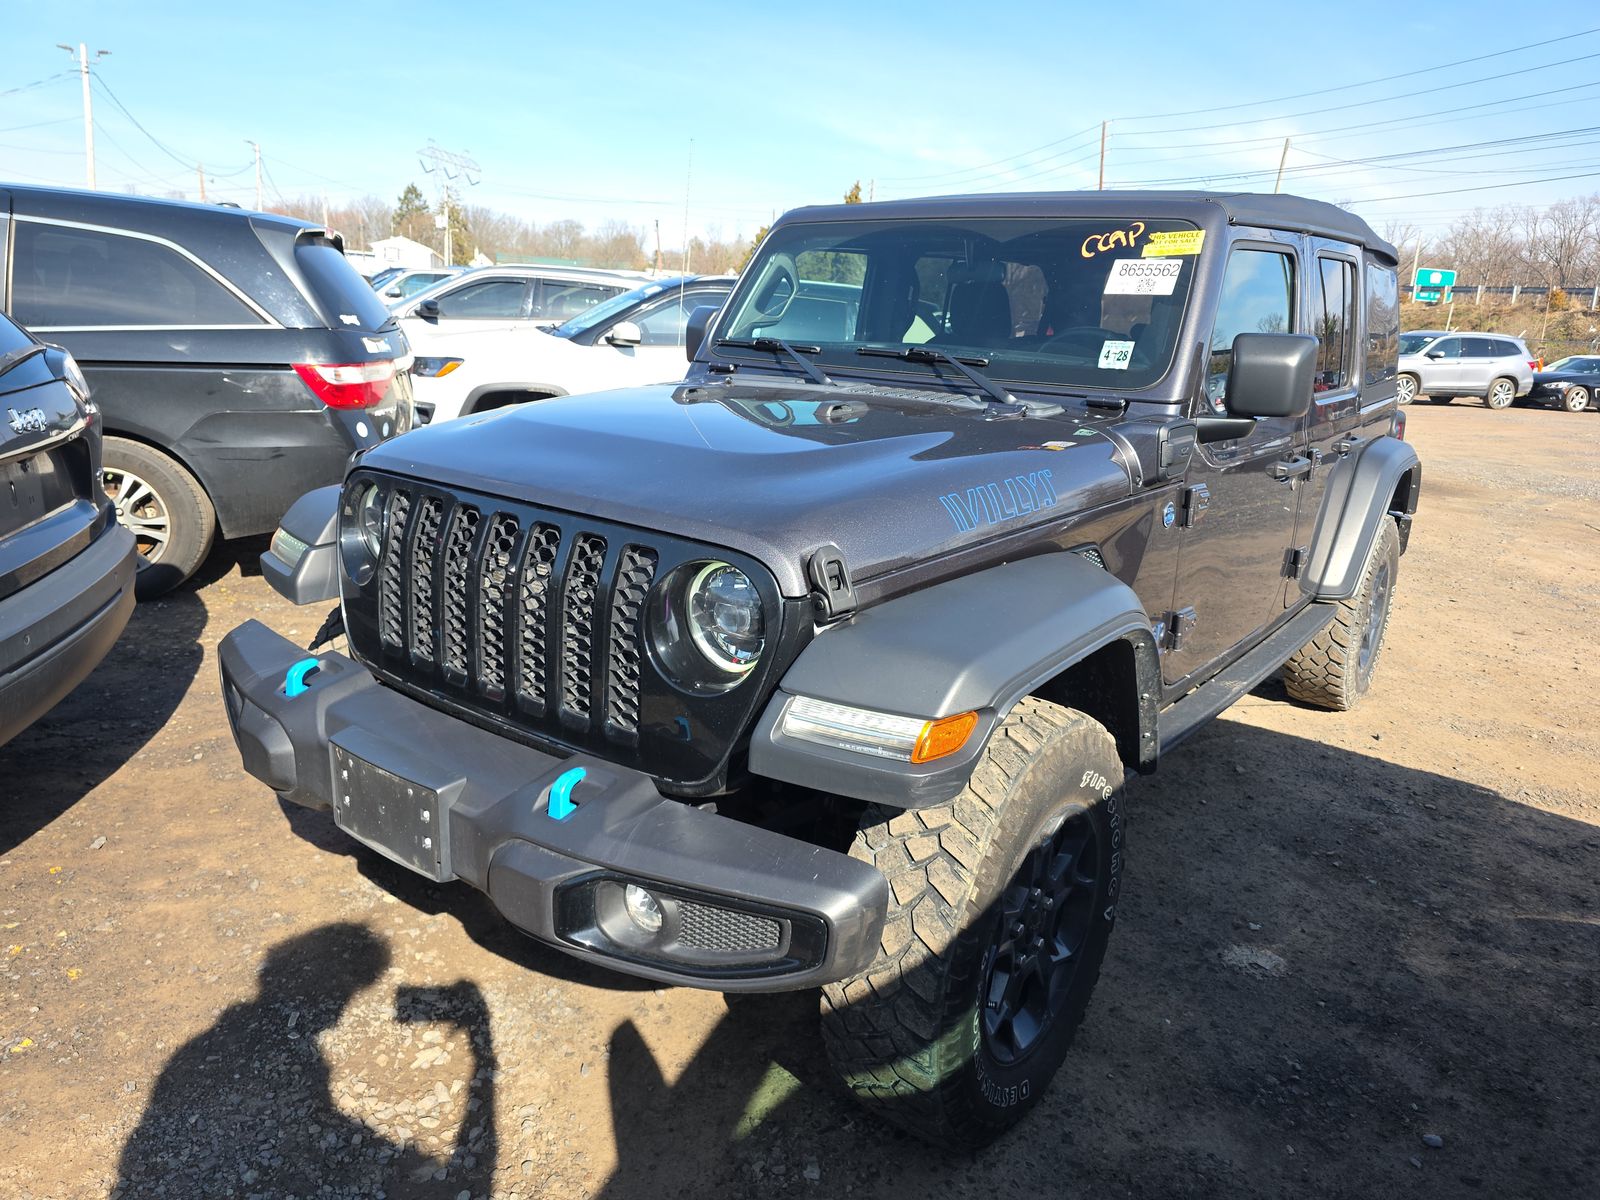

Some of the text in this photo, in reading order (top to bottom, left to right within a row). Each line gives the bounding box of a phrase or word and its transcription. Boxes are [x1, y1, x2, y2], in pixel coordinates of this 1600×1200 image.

[1081, 221, 1145, 258] CCAP
[1168, 231, 1200, 239] VEHICLE
[1119, 264, 1180, 277] 8655562
[8, 408, 47, 434] Jeep
